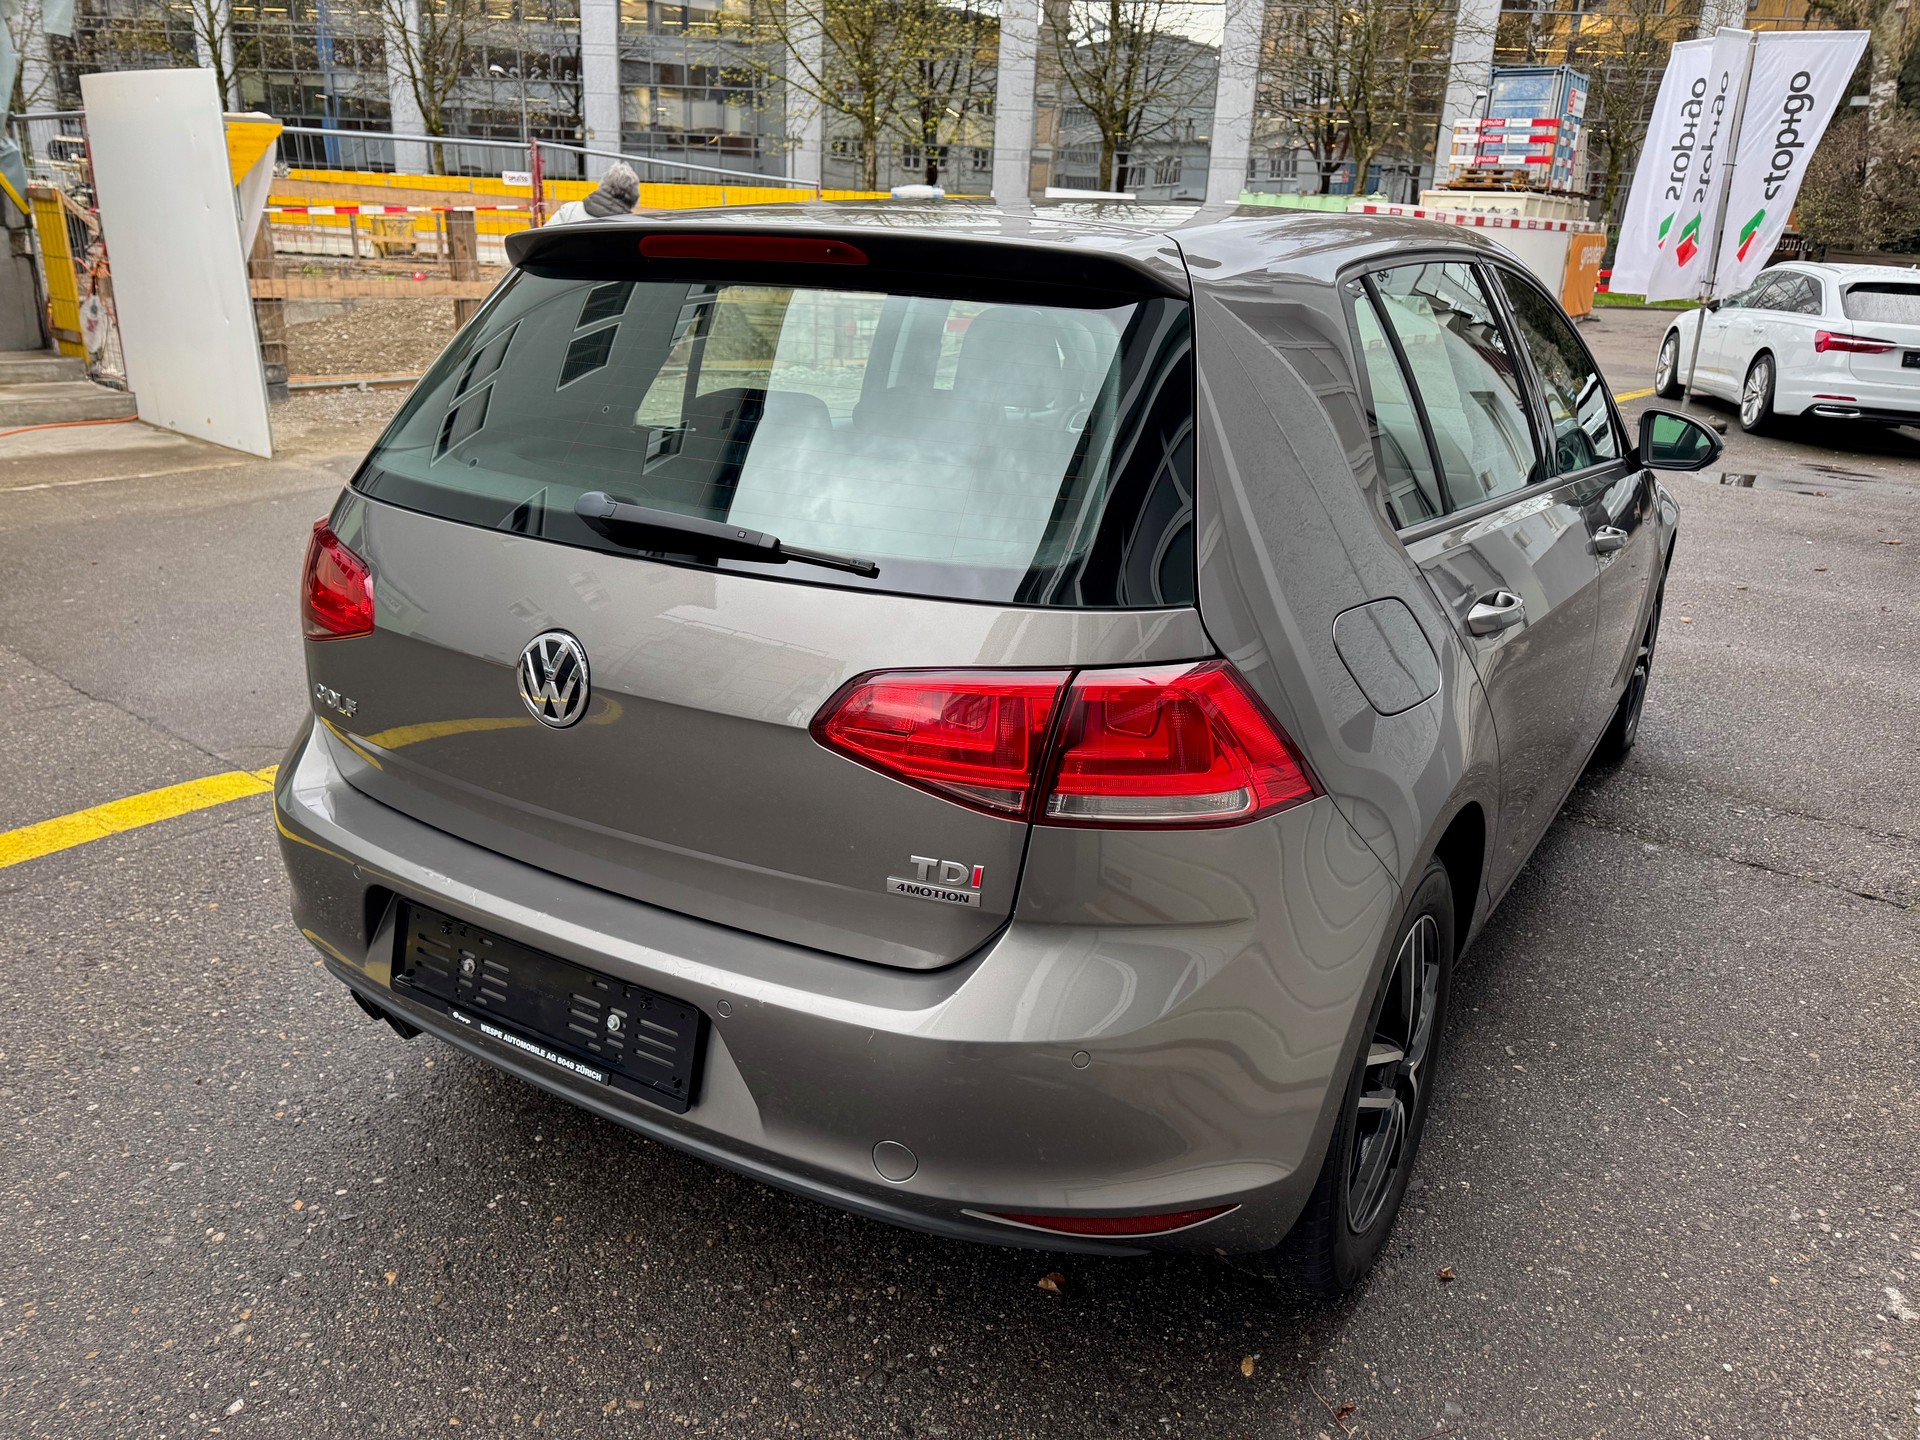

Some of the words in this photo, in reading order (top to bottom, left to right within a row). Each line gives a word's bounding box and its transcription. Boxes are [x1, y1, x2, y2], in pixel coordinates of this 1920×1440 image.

[314, 683, 358, 718] GOLF
[910, 854, 985, 889] TDI
[896, 883, 970, 903] 4MOTION
[480, 1023, 503, 1039] WESPE
[503, 1033, 546, 1058] AUTOMOBILE
[546, 1052, 557, 1062] AG
[557, 1056, 575, 1070] 8048
[575, 1064, 602, 1082] ZÜRICH
